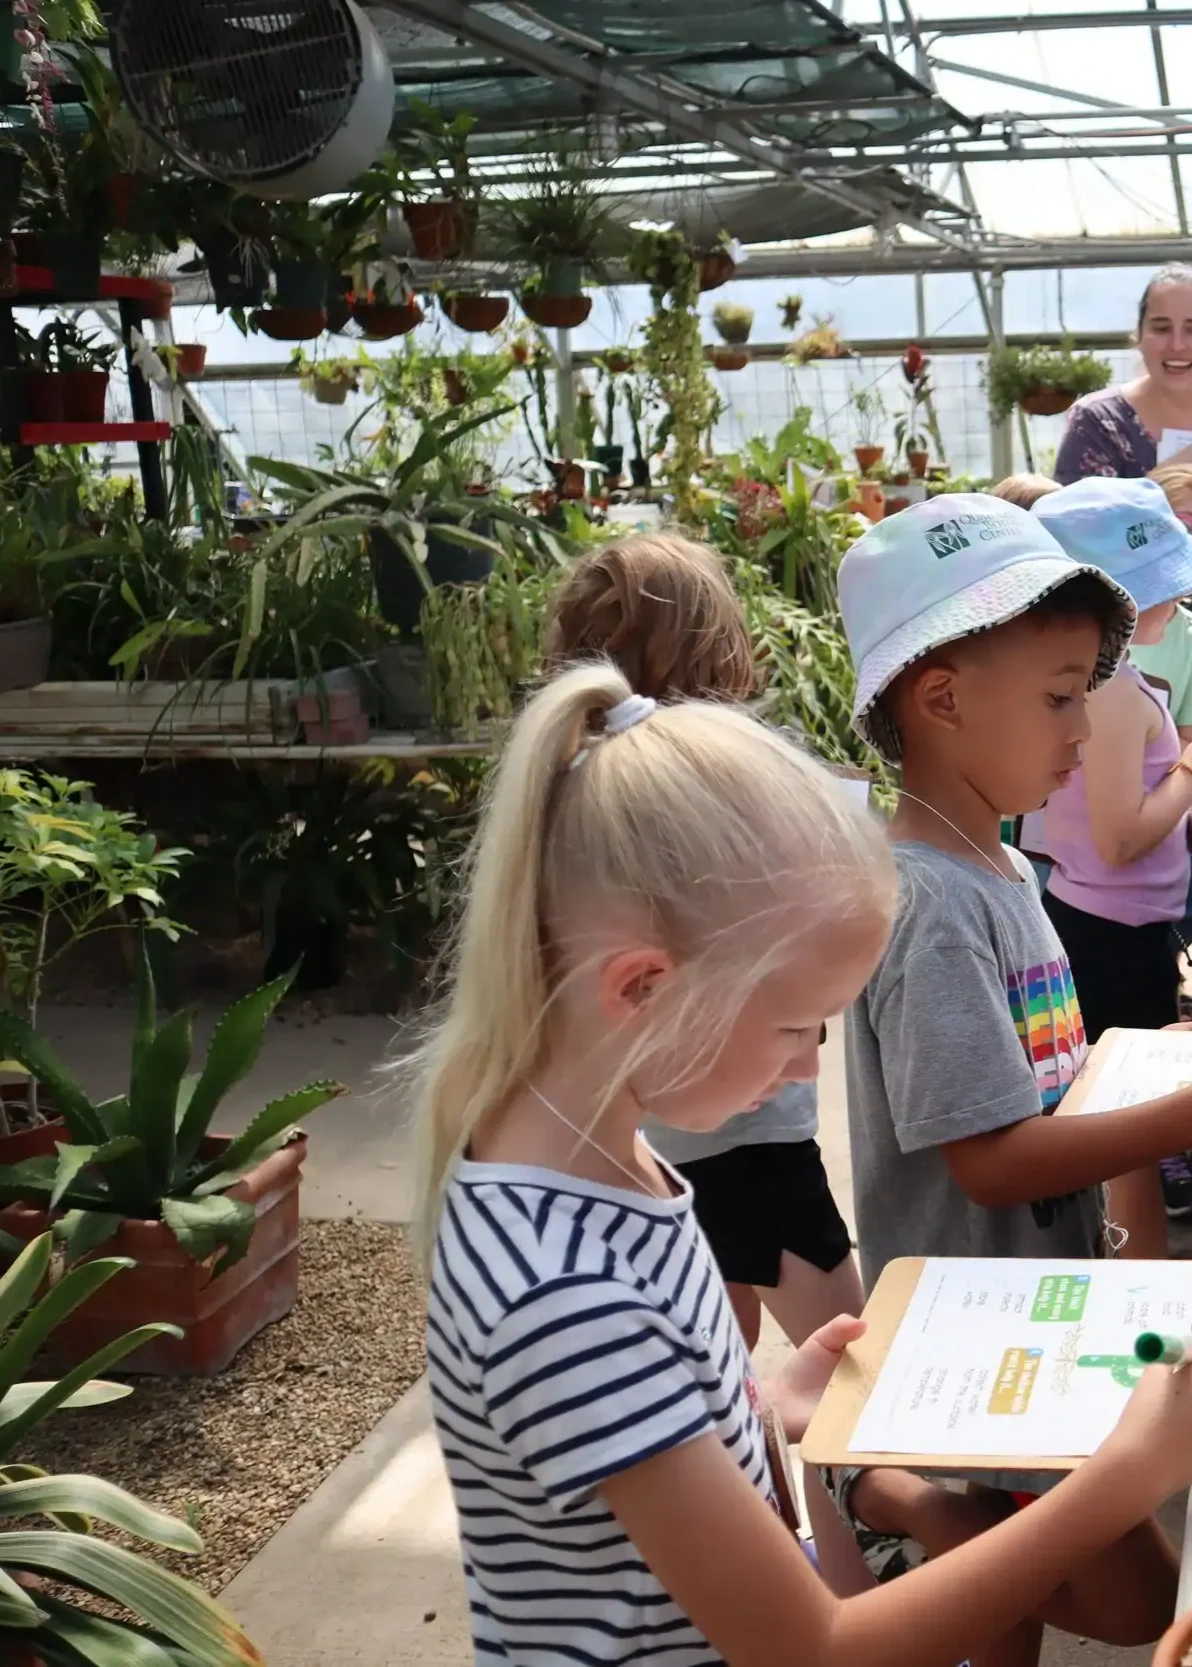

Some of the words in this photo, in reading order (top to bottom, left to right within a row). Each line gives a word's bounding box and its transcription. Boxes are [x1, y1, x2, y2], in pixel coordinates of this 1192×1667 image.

[1053, 1292, 1068, 1303] and
[959, 1368, 976, 1382] from
[955, 1385, 970, 1396] the
